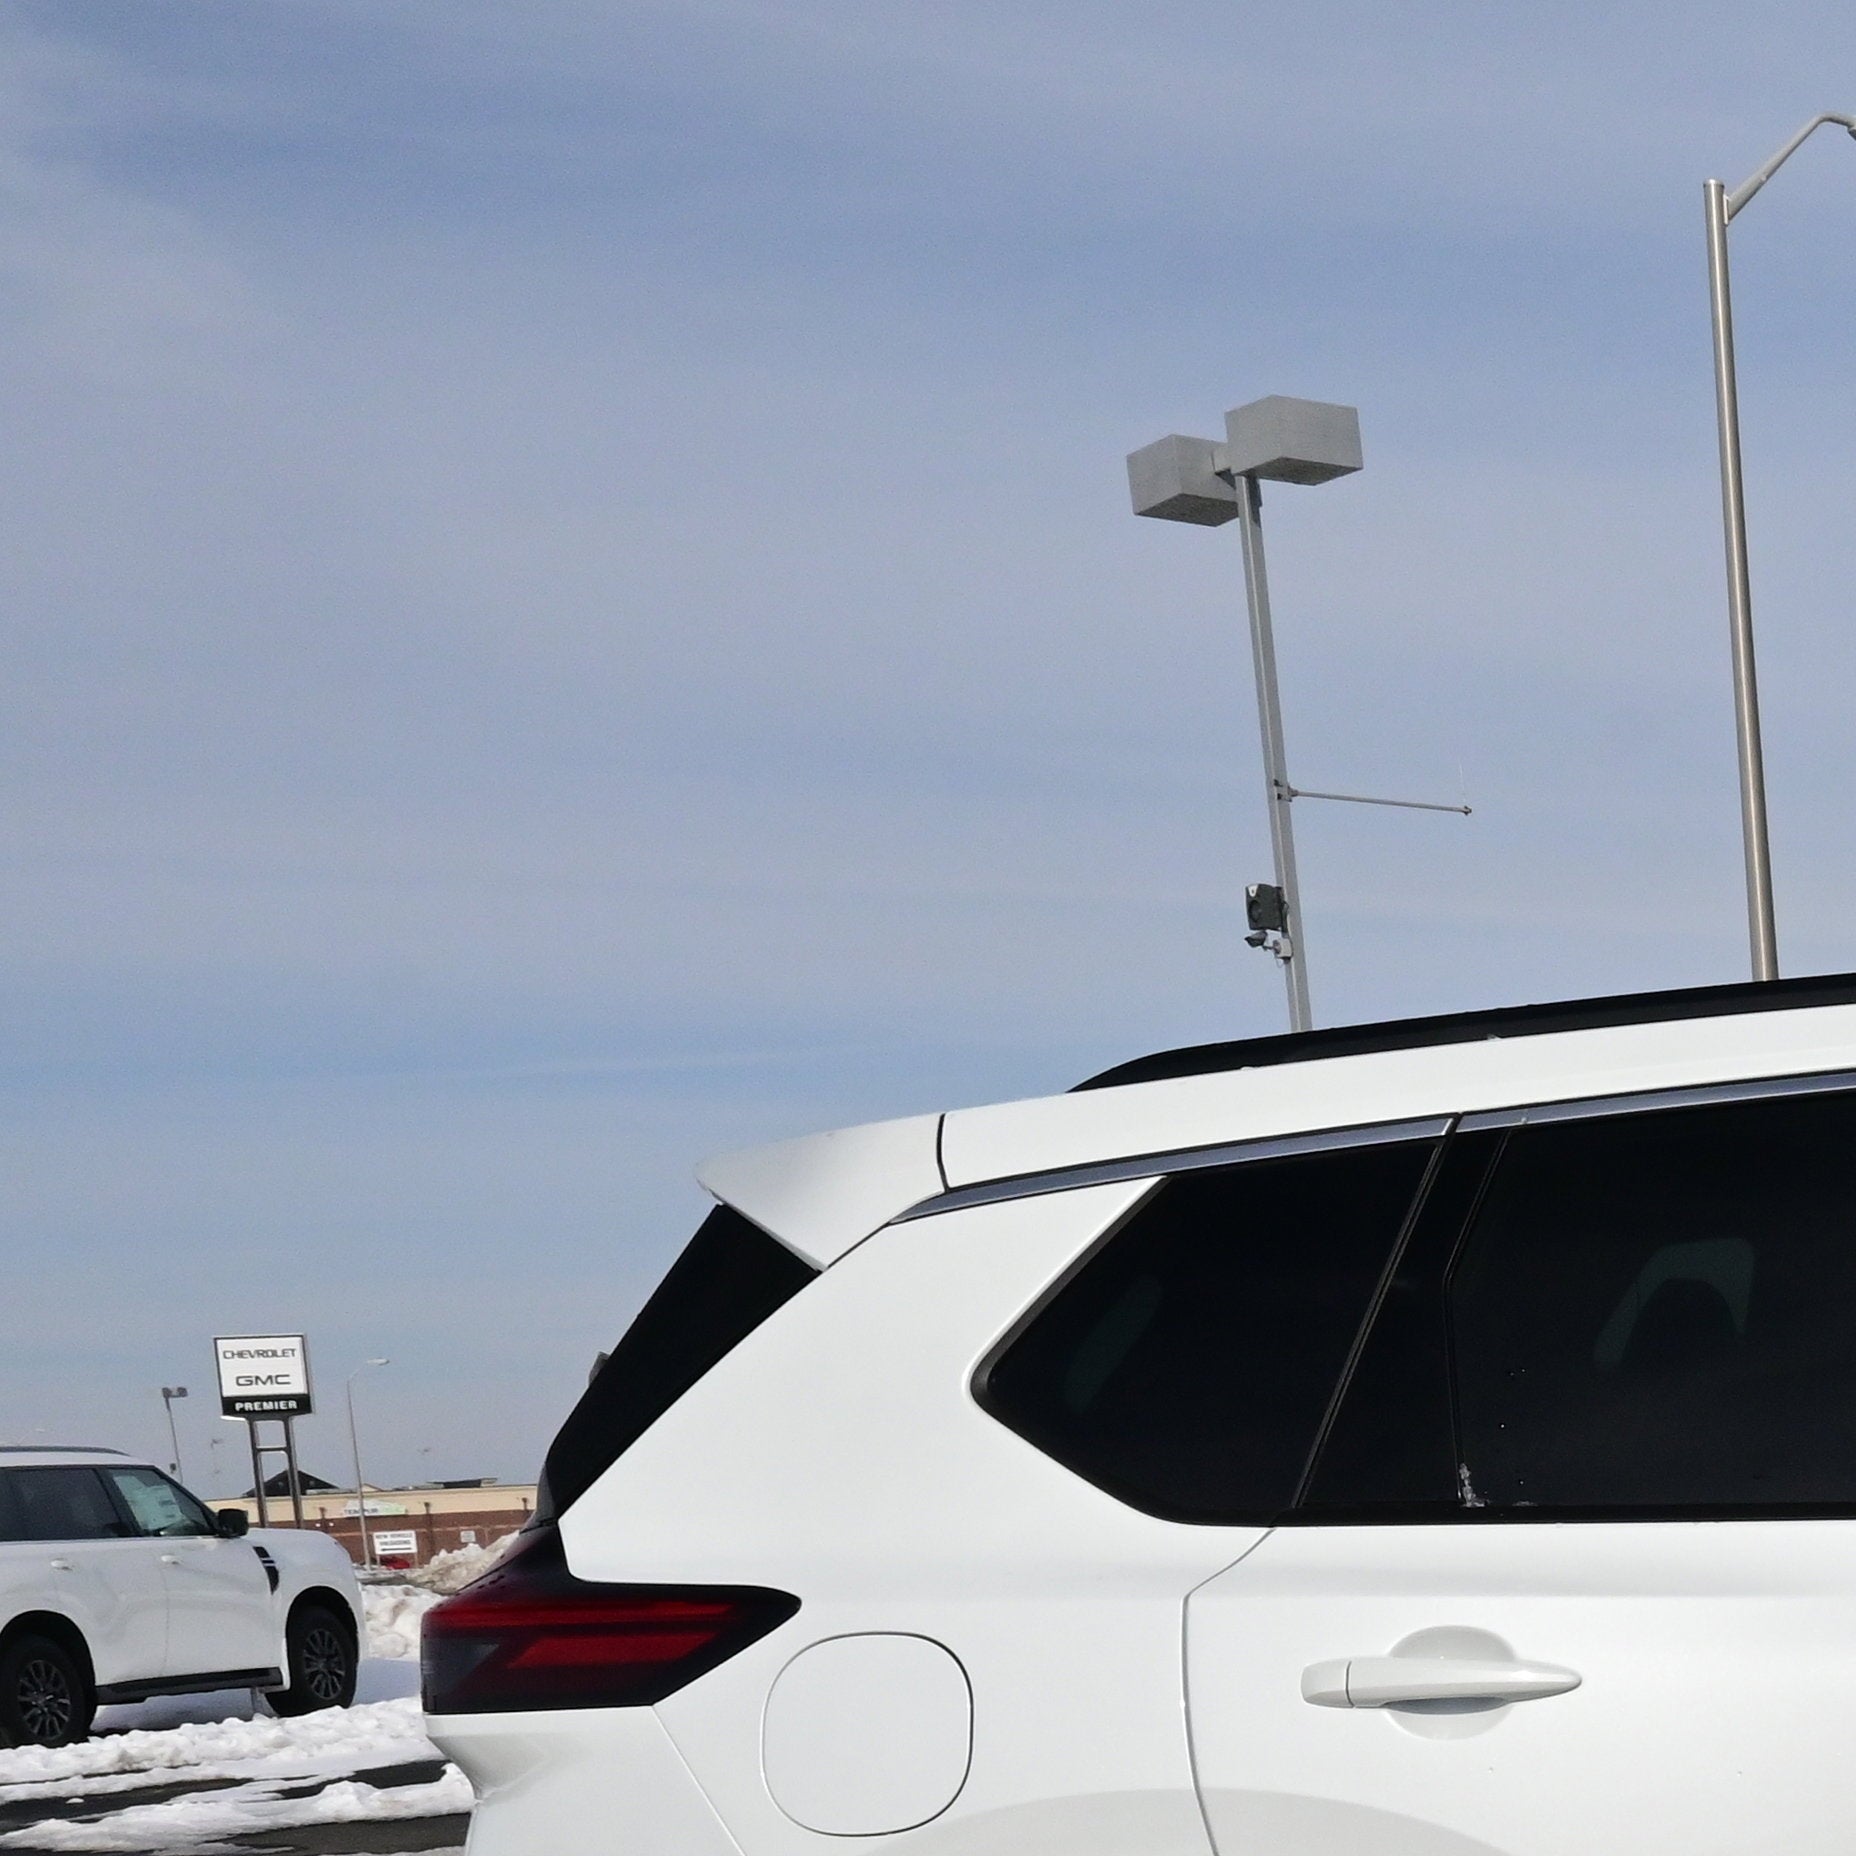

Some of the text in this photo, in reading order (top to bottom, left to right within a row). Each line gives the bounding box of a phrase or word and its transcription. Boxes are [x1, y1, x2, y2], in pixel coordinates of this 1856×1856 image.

[223, 1348, 297, 1360] CHEVROLET
[235, 1374, 292, 1387] GMC
[235, 1400, 298, 1412] PREMIER
